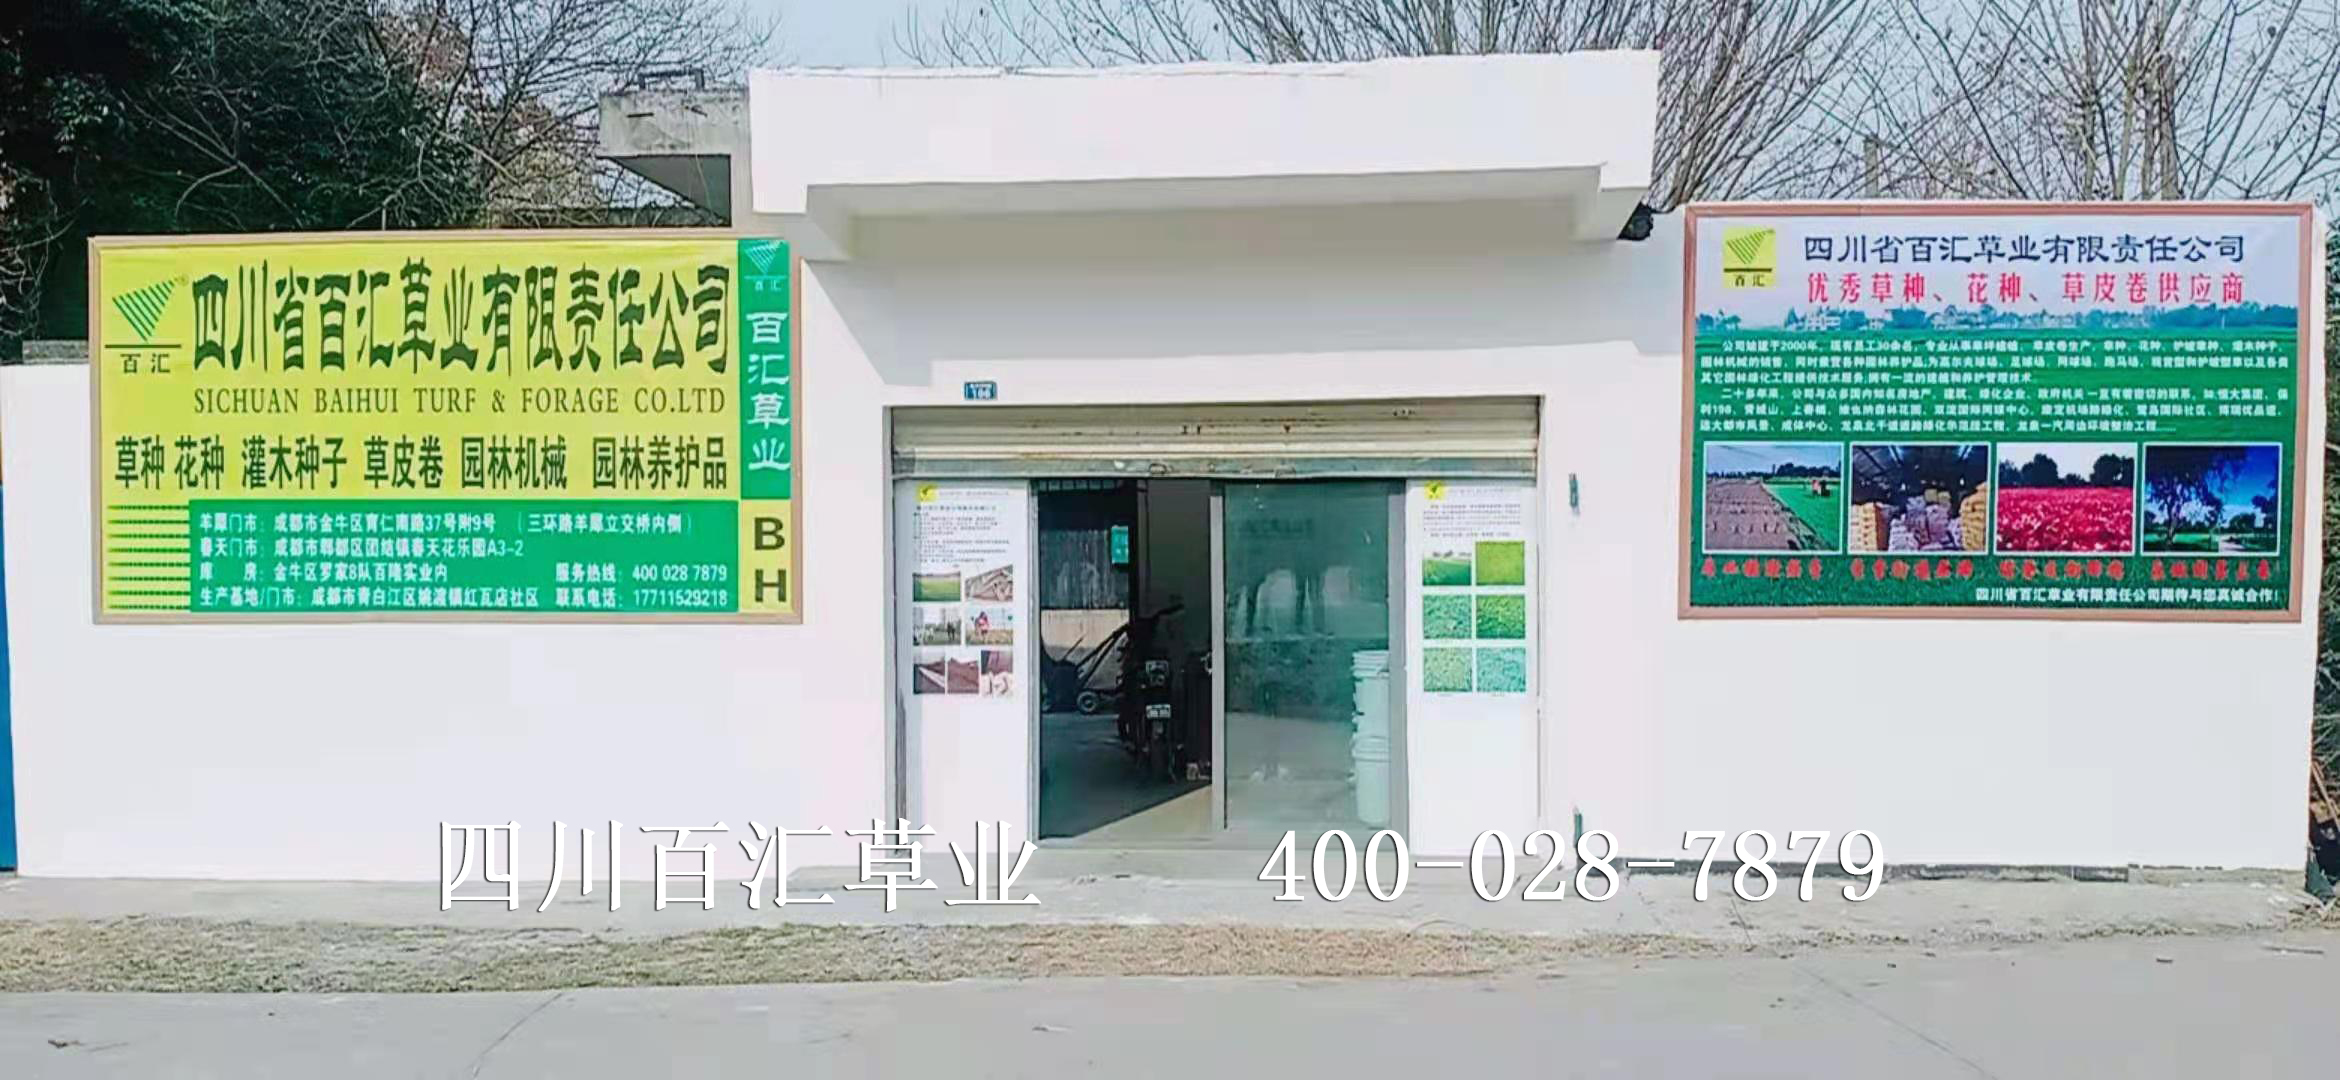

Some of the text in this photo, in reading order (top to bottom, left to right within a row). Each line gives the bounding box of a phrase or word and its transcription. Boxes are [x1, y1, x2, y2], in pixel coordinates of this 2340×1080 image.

[1804, 234, 2244, 264] 四川省百汇草业有限责任公司
[1807, 272, 2244, 304] 优秀草种、花种、草皮卷供应商
[192, 256, 730, 376] 四川省百汇草业有限责任公司
[119, 353, 171, 374] 百汇
[194, 388, 725, 414] SICHUAN BAIHUI TURF & FORAGE CO.LTD
[746, 312, 790, 472] 百汇草业
[115, 434, 727, 490] 草种 花种 灌木种子 草皮卷 园林机械 园林养护品
[754, 517, 785, 550] B
[632, 566, 658, 582] 400
[662, 566, 688, 582] 028
[693, 566, 728, 582] 7879
[755, 569, 787, 603] H
[634, 590, 728, 606] 17711529218
